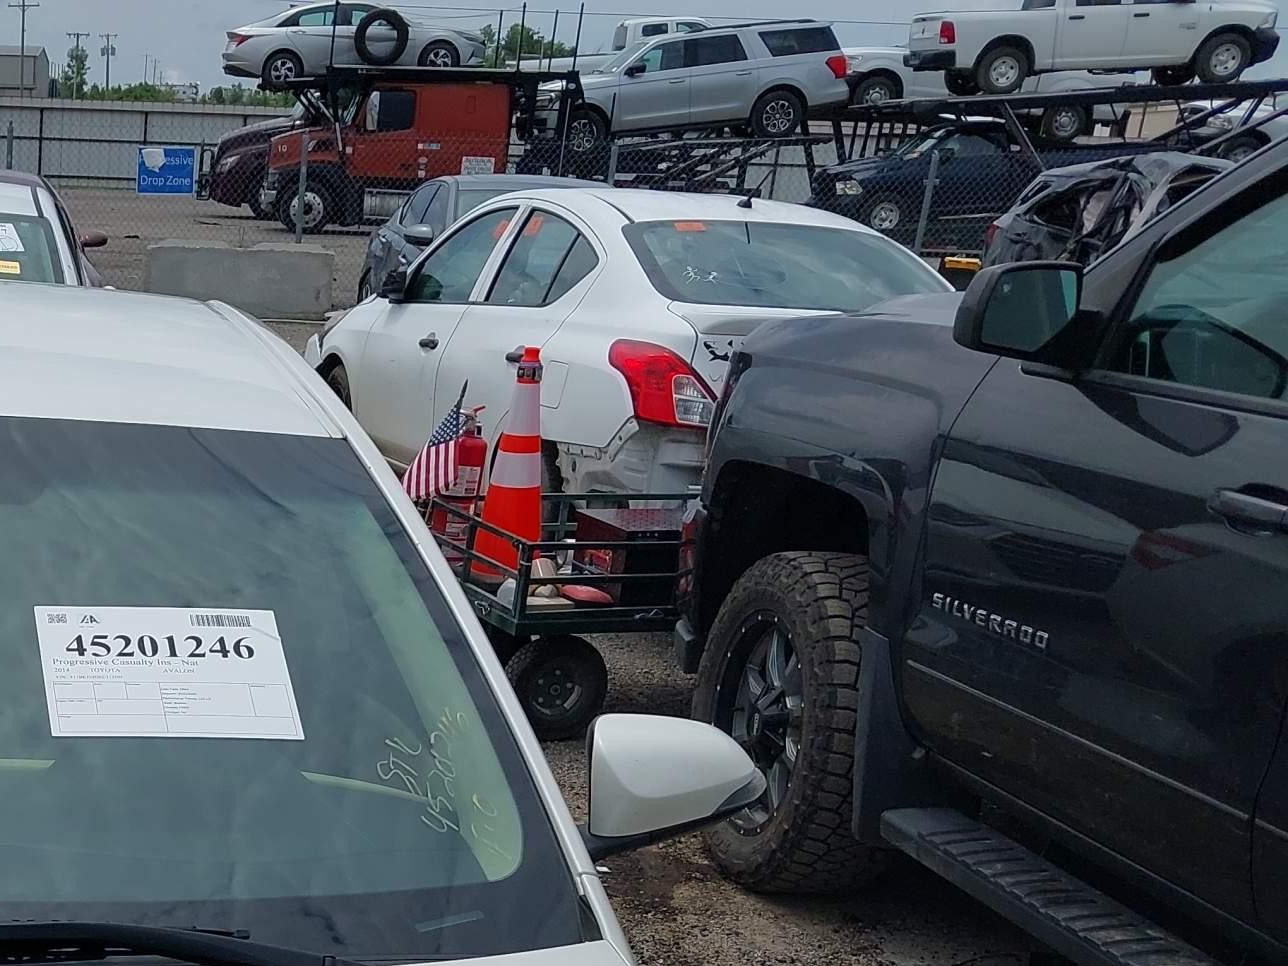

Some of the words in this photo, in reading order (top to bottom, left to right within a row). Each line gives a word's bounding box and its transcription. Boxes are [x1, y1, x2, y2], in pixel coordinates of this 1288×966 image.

[140, 175, 165, 187] Drop
[166, 176, 191, 186] Zone
[932, 592, 1049, 649] SILVERADO
[65, 634, 256, 660] 45201246
[52, 658, 108, 667] Progressive
[111, 658, 154, 667] Casualty
[157, 658, 172, 667] Ins
